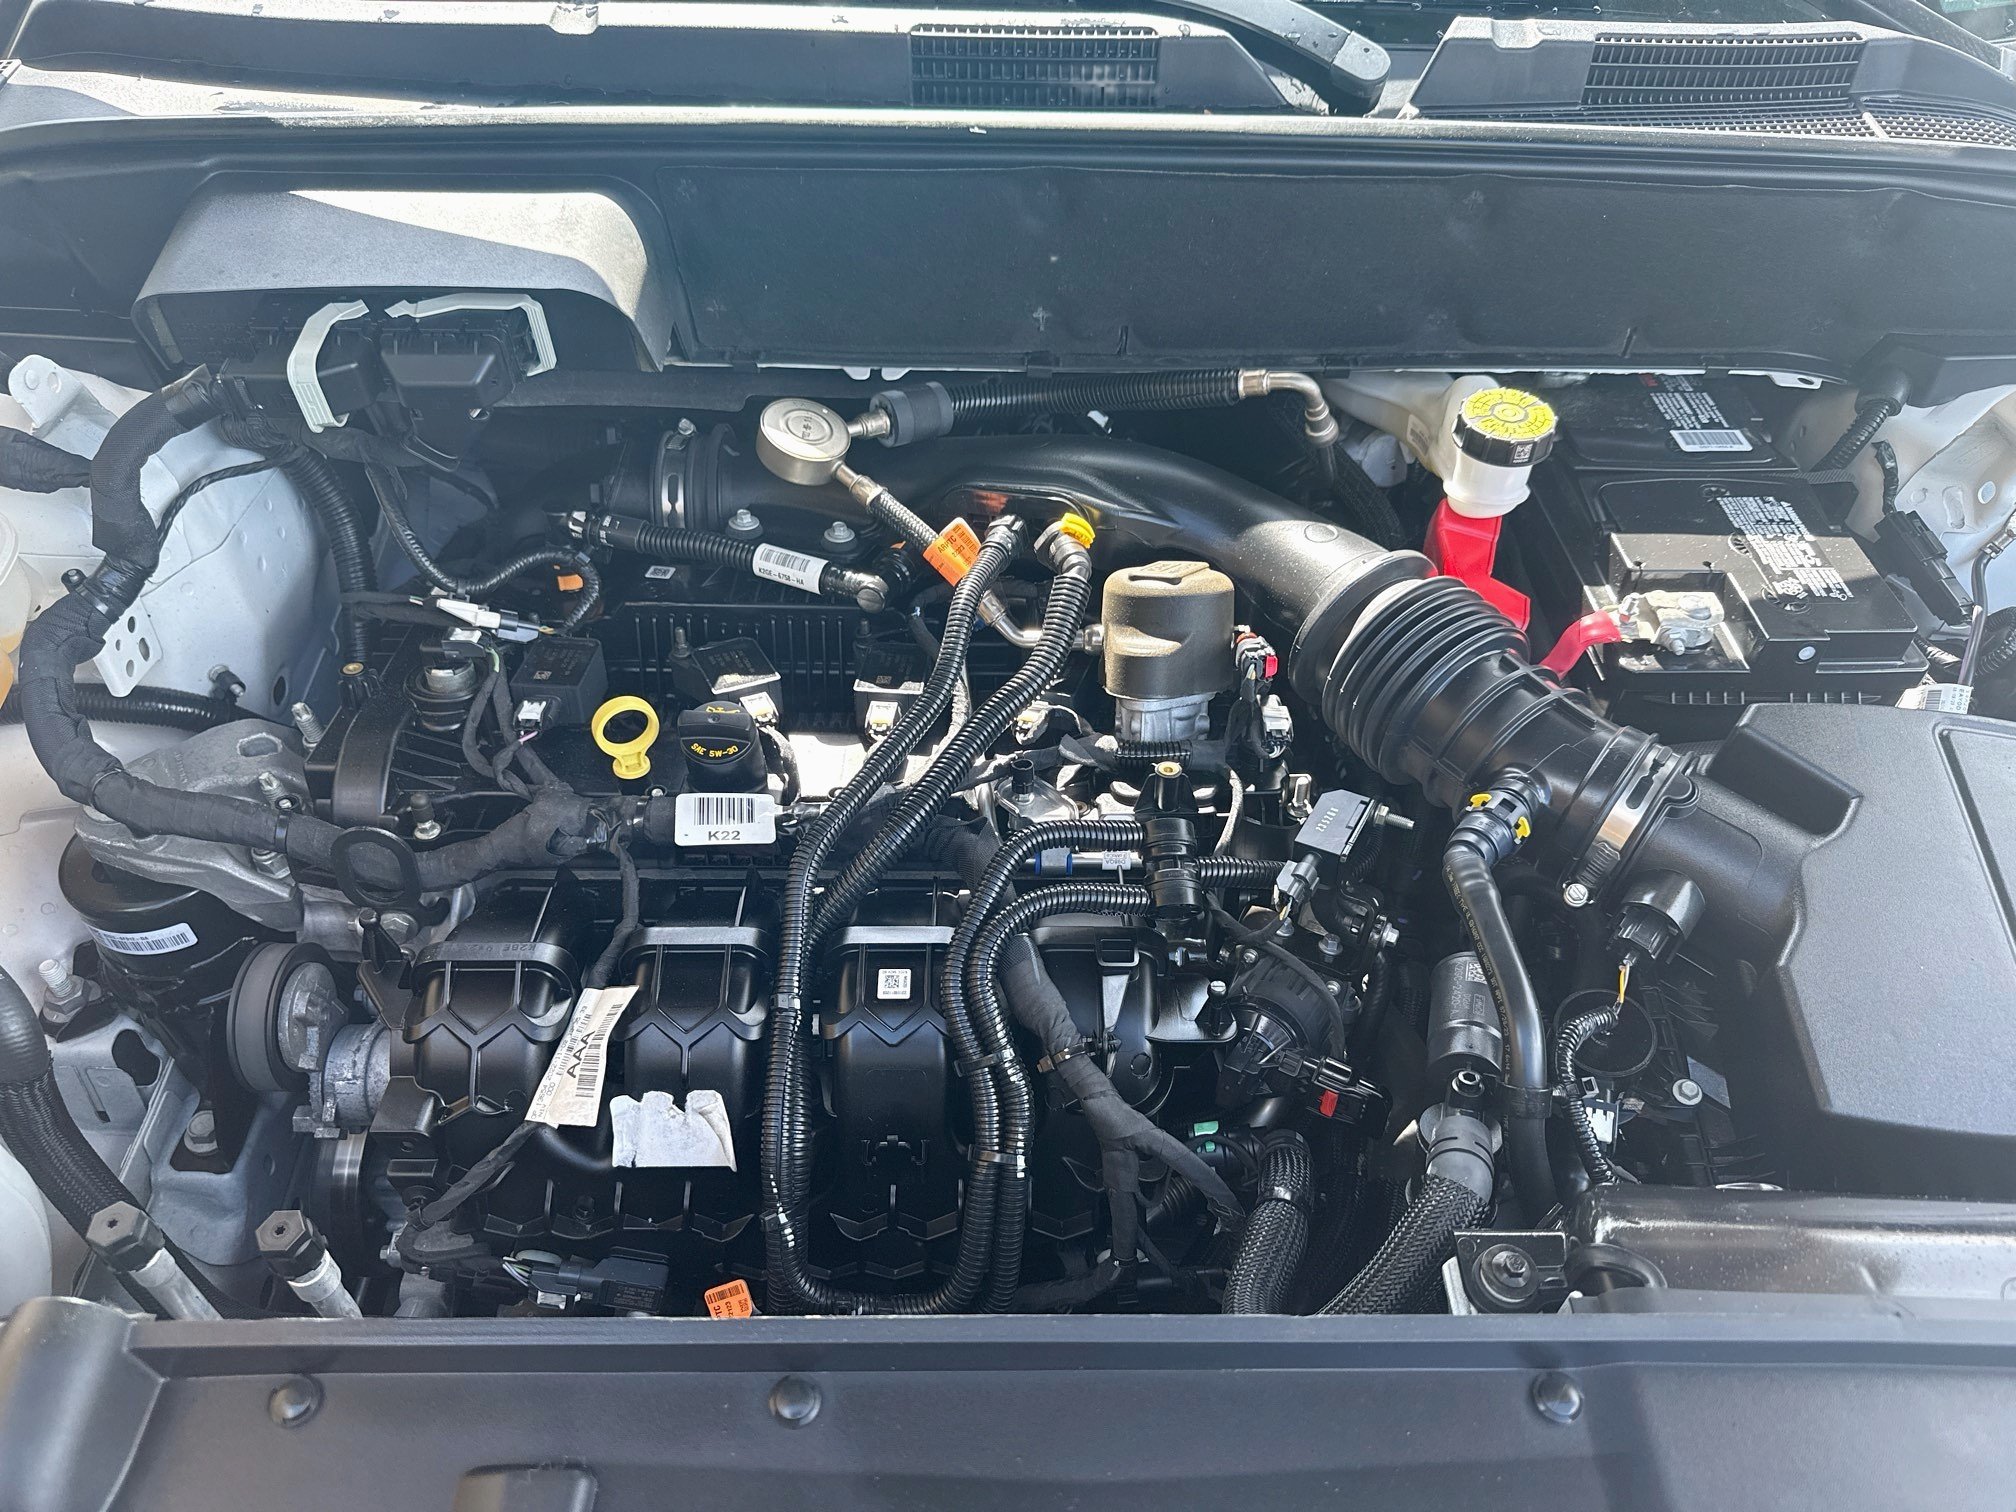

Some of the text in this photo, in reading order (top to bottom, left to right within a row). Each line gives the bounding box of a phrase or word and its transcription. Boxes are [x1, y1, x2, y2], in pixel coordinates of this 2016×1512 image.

[690, 742, 739, 758] SAE 5W-30
[708, 830, 741, 841] K22
[566, 1030, 596, 1079] AAA
